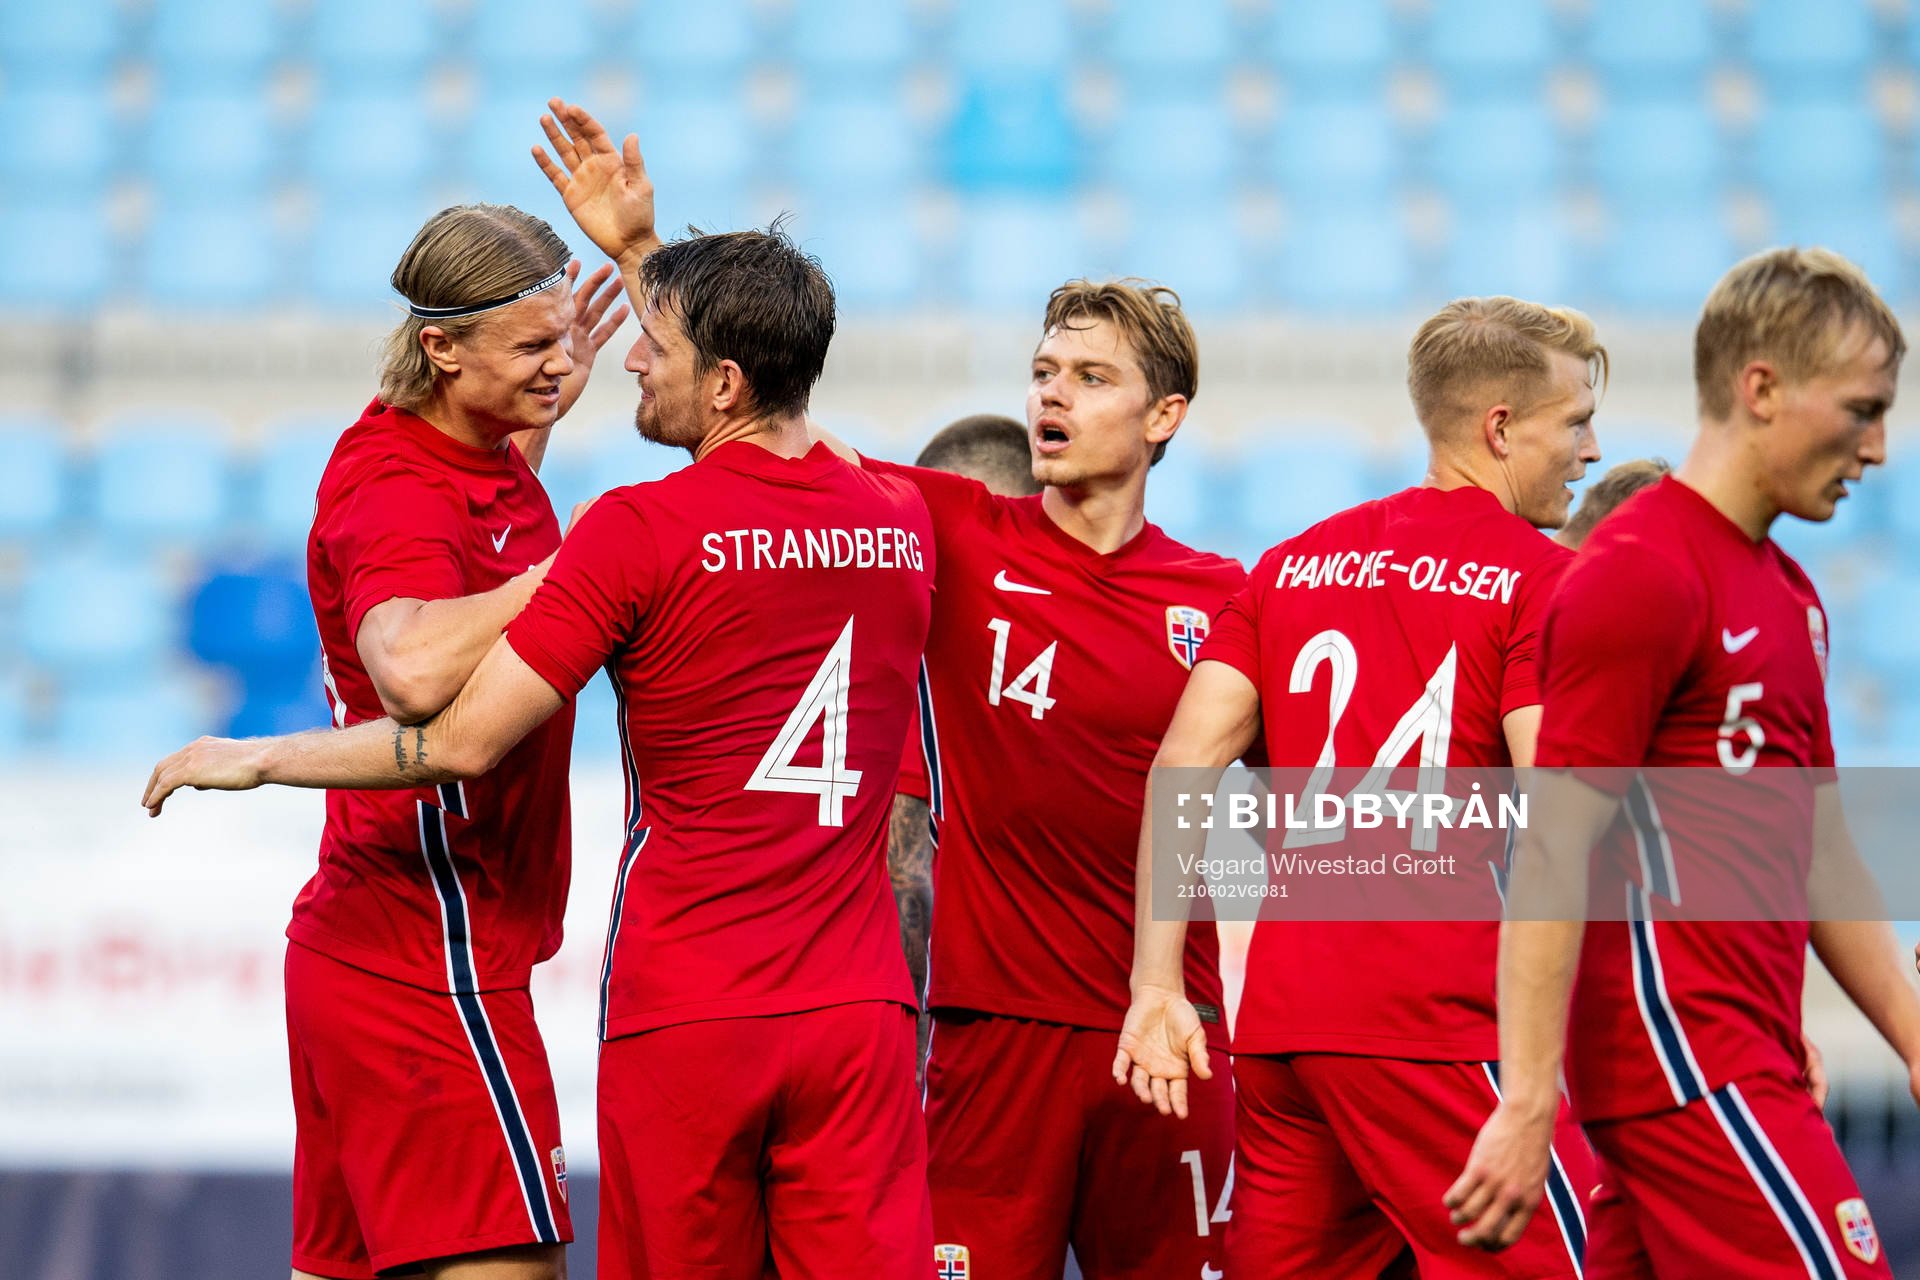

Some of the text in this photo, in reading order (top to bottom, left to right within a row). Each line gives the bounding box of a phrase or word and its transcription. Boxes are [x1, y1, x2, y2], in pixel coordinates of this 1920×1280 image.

[701, 527, 924, 573] STRANDBERG
[1275, 549, 1521, 605] HANCHE-OLSEN
[987, 617, 1058, 720] 14
[743, 614, 863, 827] 4
[1281, 628, 1467, 853] 24
[1716, 682, 1766, 776] 5
